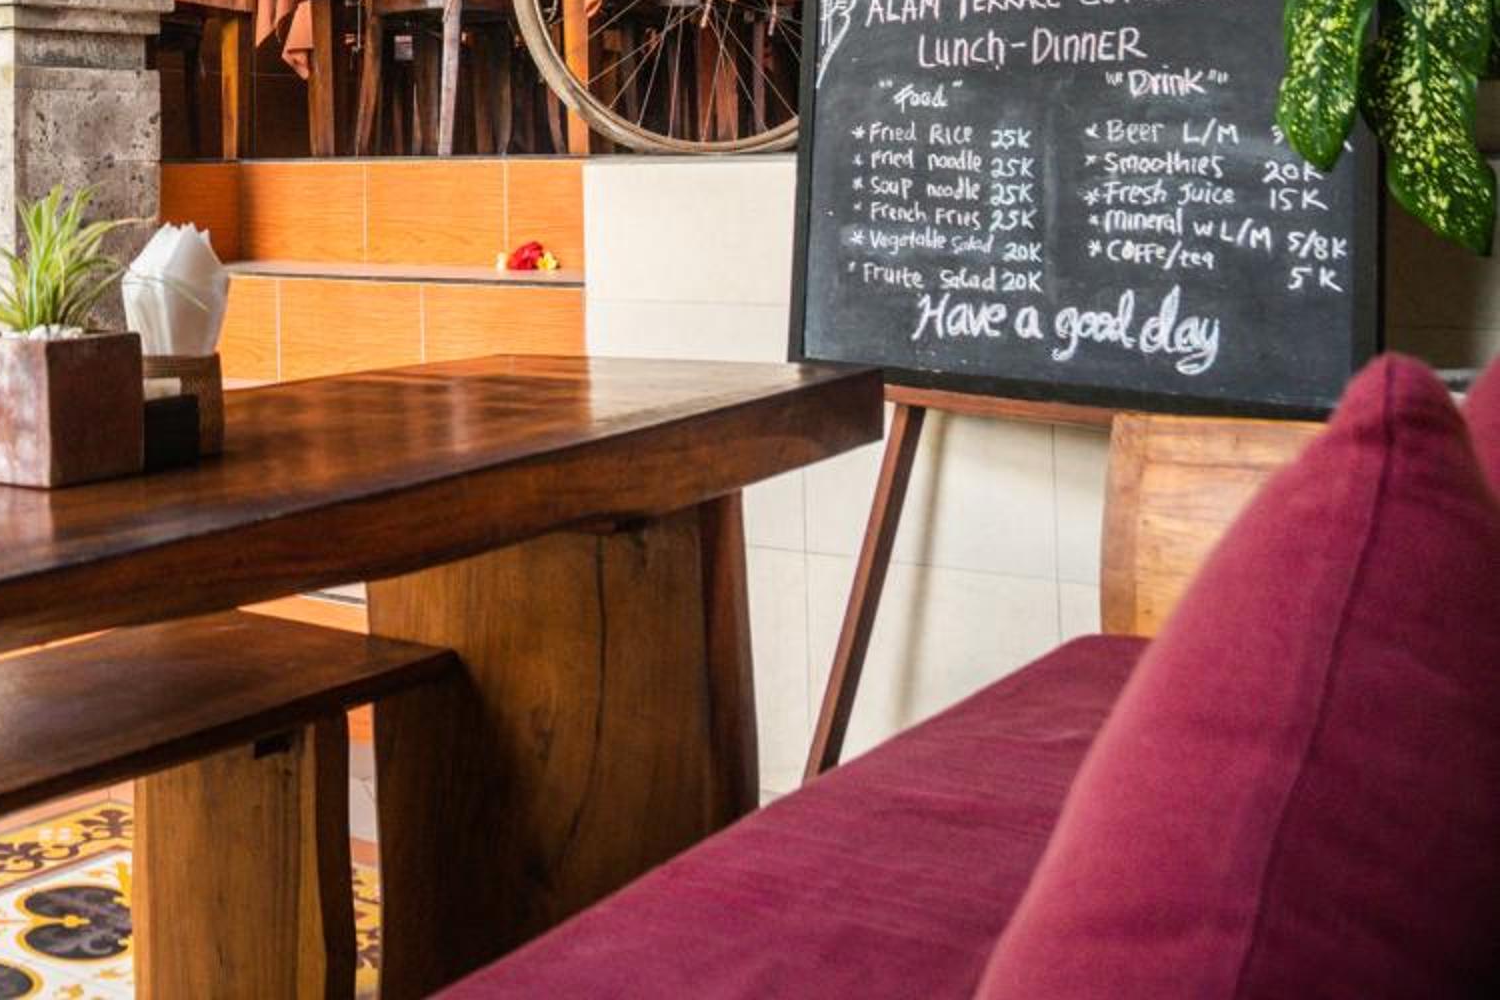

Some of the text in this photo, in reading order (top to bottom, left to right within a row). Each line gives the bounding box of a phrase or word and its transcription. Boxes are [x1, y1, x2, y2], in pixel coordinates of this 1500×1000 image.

[868, 121, 917, 144] Fried
[989, 127, 1033, 149] 25K
[1105, 119, 1165, 144] Beer
[1182, 117, 1240, 146] L/M
[927, 149, 982, 173] noodle
[989, 157, 1035, 178] 25K
[1103, 149, 1226, 179] Smoothies
[926, 175, 981, 200] noodle
[989, 182, 1034, 205] 25K
[1102, 178, 1168, 205] Fresh
[870, 201, 927, 221] French
[988, 207, 1038, 231] 25K
[1219, 217, 1273, 251] L/M
[1002, 241, 1043, 263] 20K
[938, 266, 996, 292] Salad
[1001, 270, 1045, 293] 20K
[910, 284, 1220, 375] Have a good day
